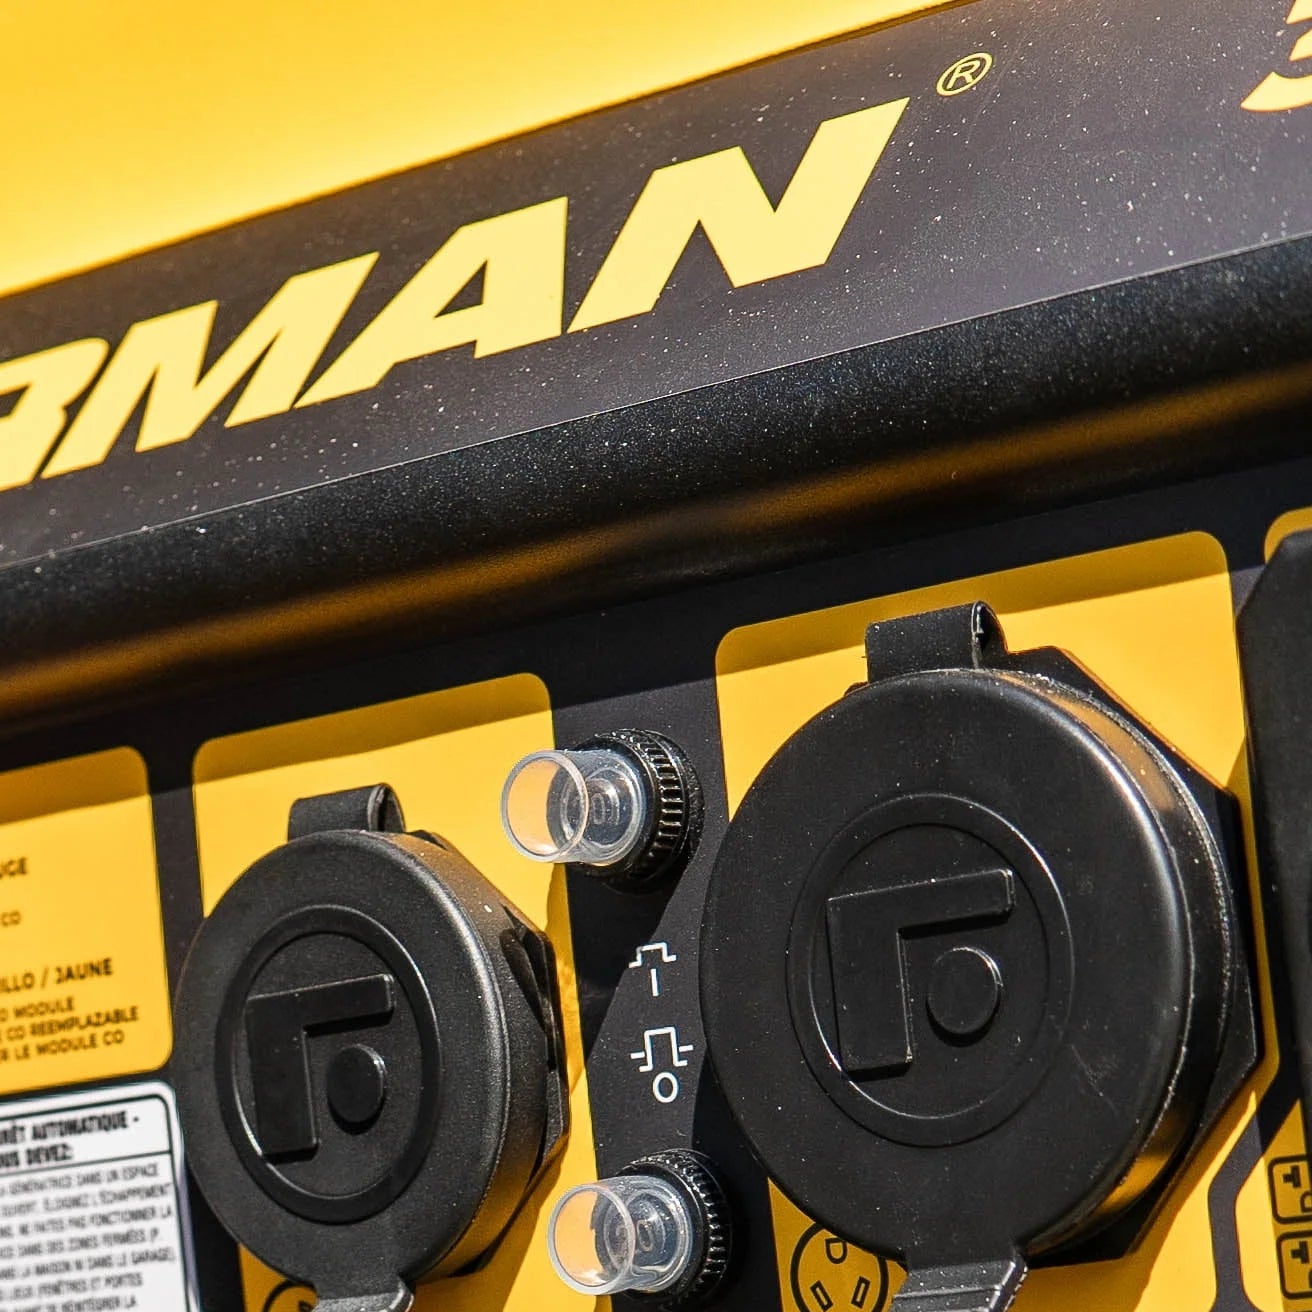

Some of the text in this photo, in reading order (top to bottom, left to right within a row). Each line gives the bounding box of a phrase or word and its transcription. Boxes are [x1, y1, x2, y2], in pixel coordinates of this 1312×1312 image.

[55, 957, 114, 985] JAUNE
[12, 996, 75, 1020] MODULE
[29, 1005, 139, 1037] REEMPLAZABLE
[15, 1046, 30, 1061] LE
[36, 1033, 98, 1057] MODULE
